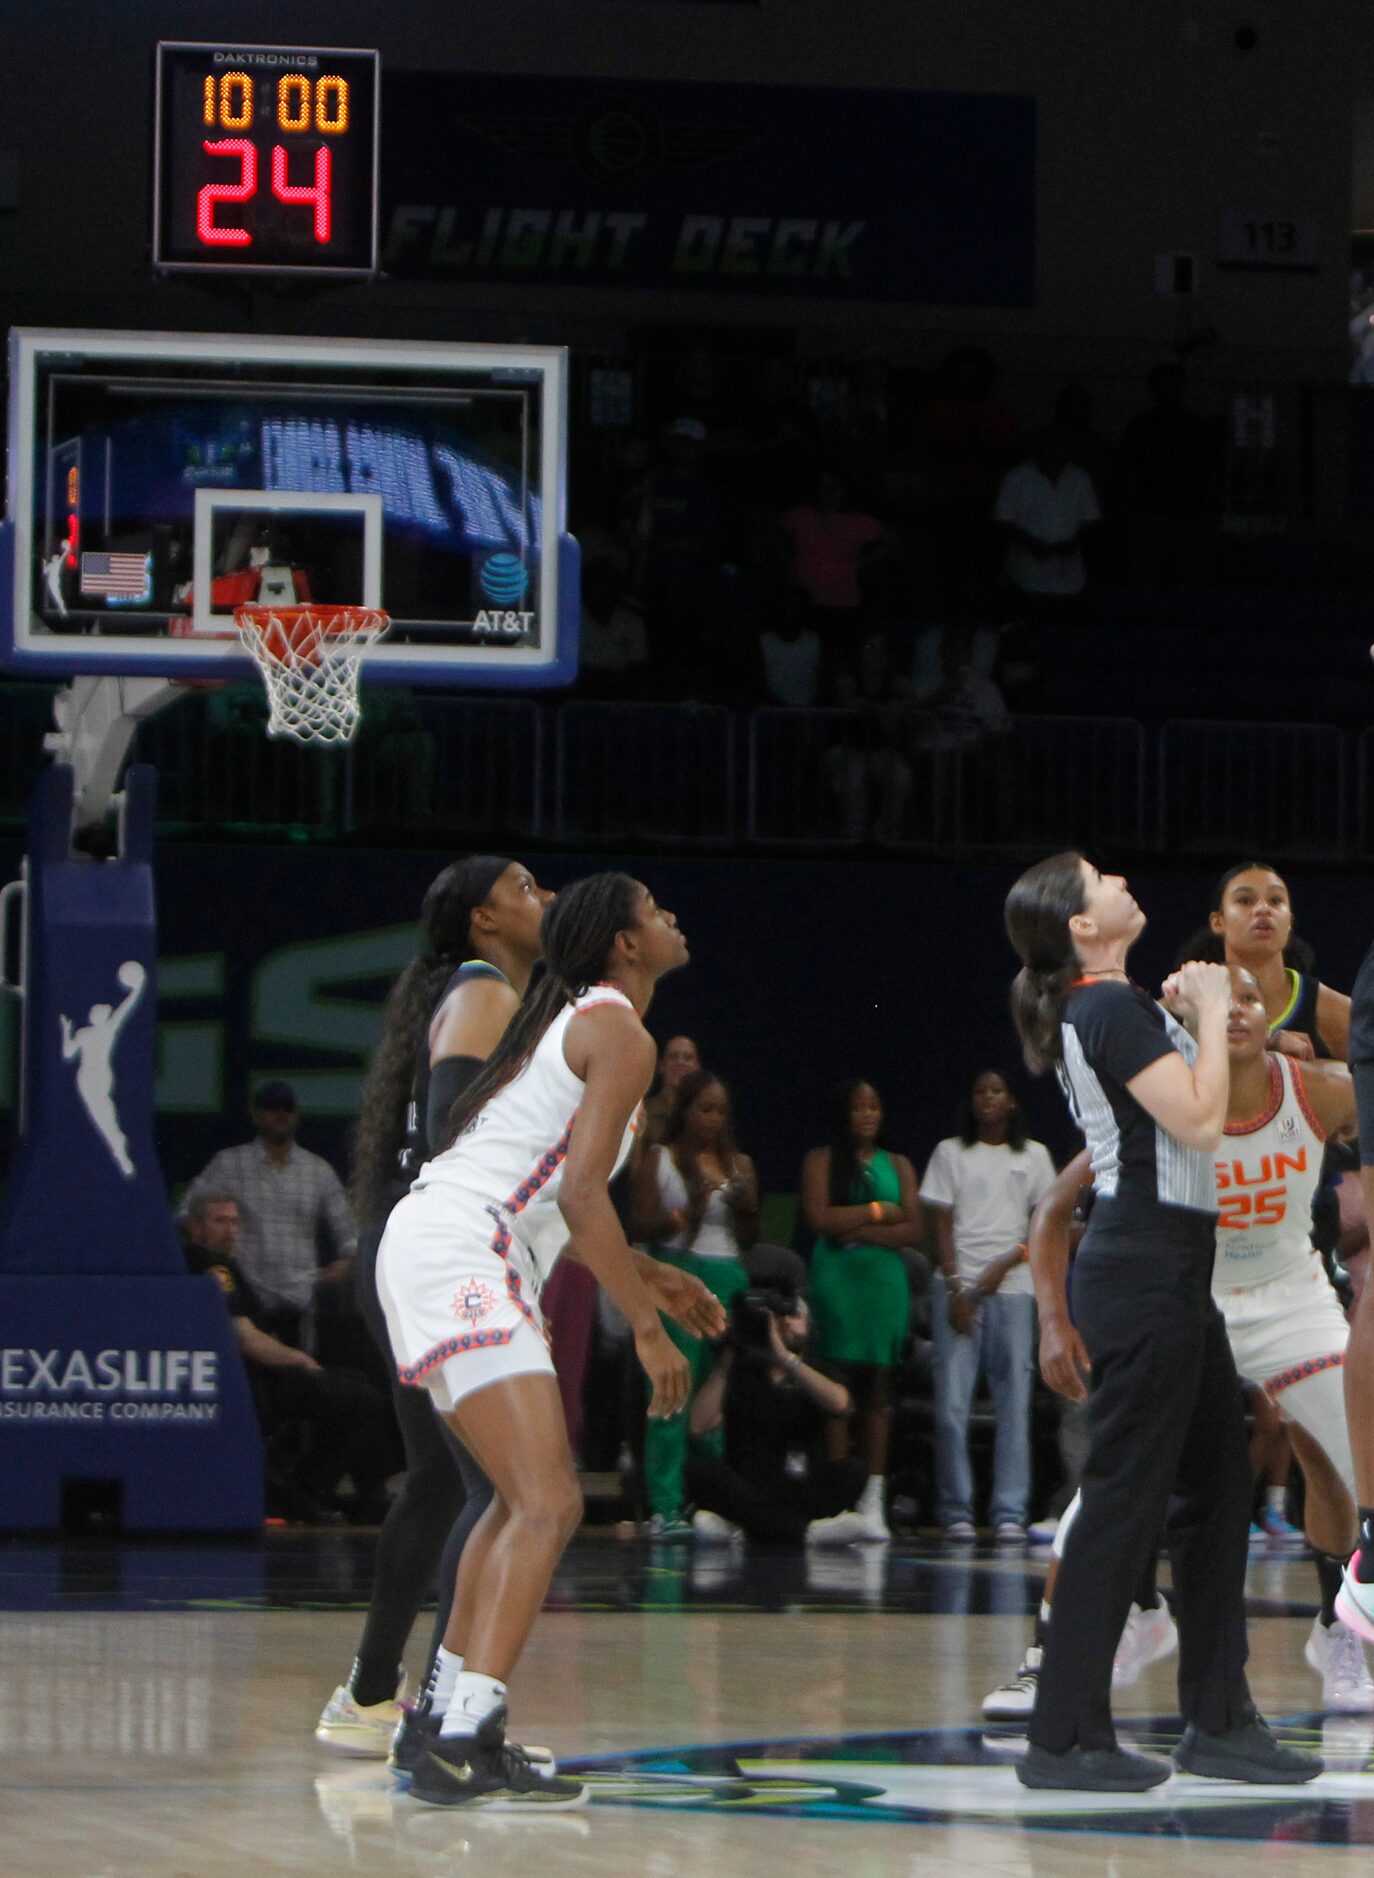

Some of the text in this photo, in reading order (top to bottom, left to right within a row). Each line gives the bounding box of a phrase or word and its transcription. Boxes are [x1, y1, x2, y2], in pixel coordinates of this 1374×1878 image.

[213, 51, 318, 66] DAKTRONICS
[197, 138, 332, 247] 24
[383, 203, 867, 279] FLIGHT DECK
[1244, 221, 1296, 252] 113
[472, 609, 535, 632] AT&T
[1216, 1185, 1287, 1230] 25
[1, 1348, 217, 1391] EXASLIFE
[0, 1401, 218, 1419] SURANCE COMPANY
